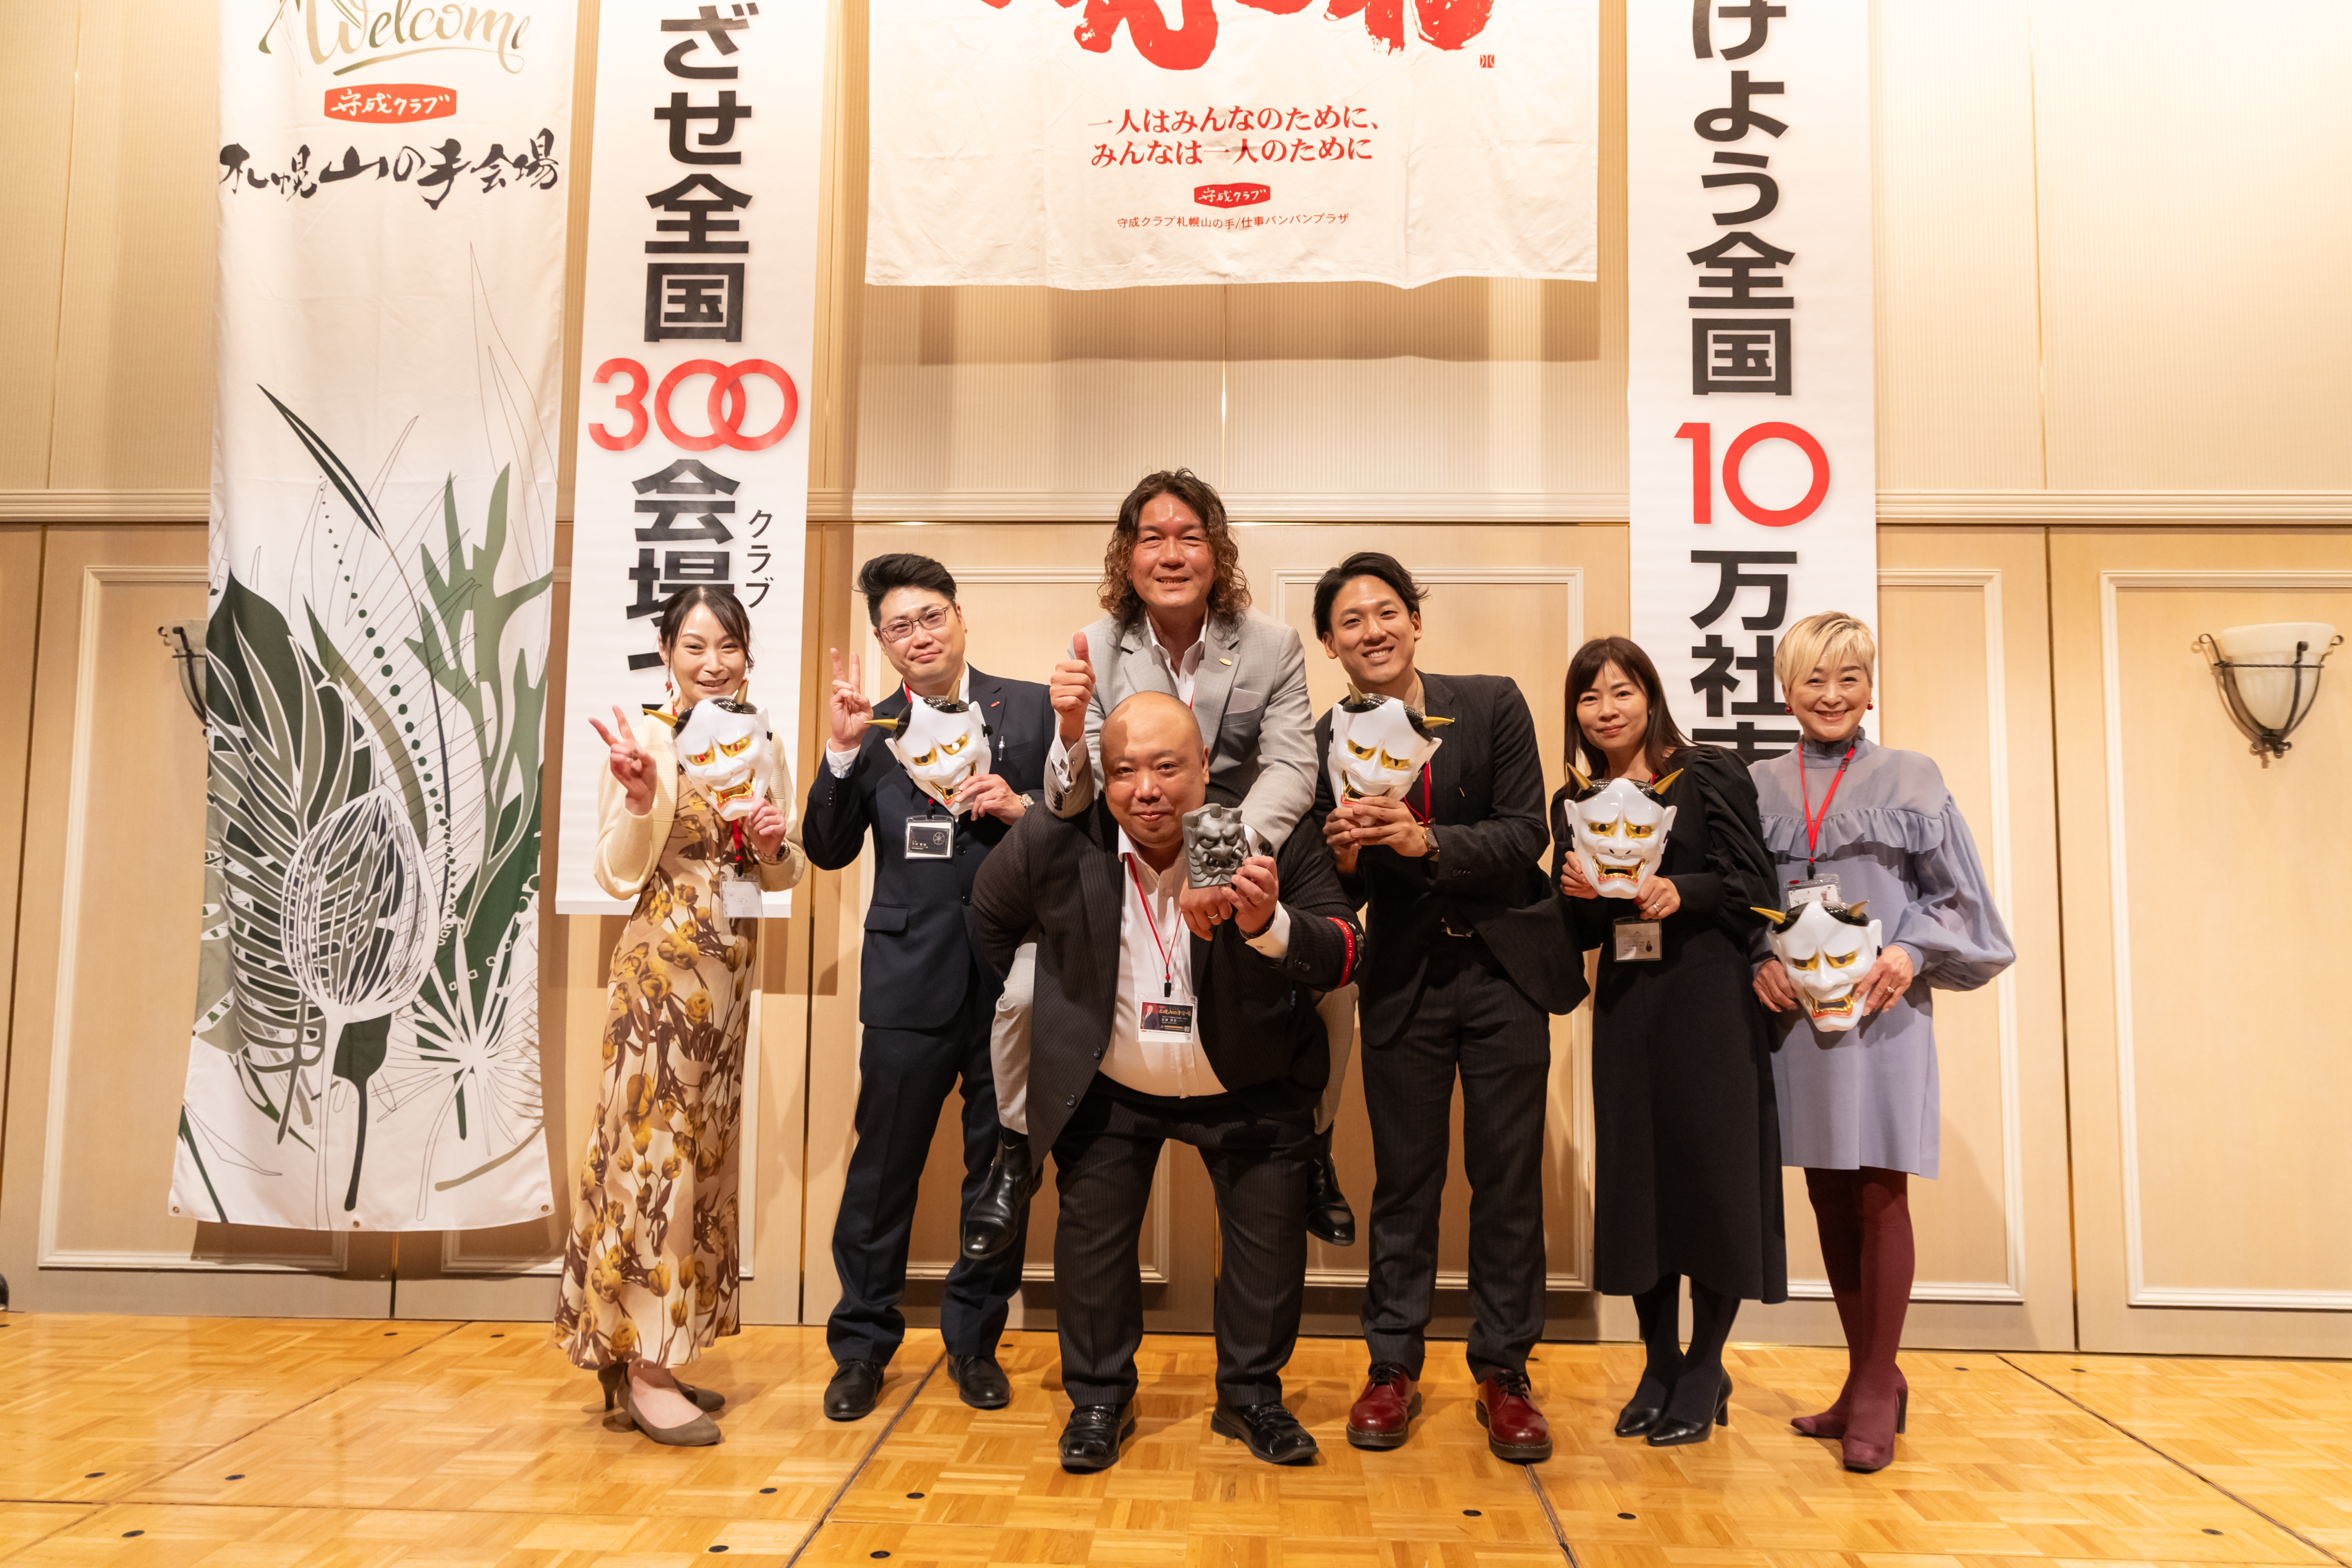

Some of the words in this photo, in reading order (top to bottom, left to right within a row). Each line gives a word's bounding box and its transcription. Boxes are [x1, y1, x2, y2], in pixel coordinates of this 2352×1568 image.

[330, 88, 450, 116] 守成クラブ
[1088, 105, 1378, 135] 一人はみんなのために、
[1091, 136, 1373, 168] みんなは一人のために
[219, 128, 559, 210] 札幌山の手会場
[1198, 189, 1267, 203] 守成クラブ
[1117, 212, 1349, 230] 守成クラブ札幌山の手/仕事バンバンプラザ
[745, 510, 774, 609] クラブ
